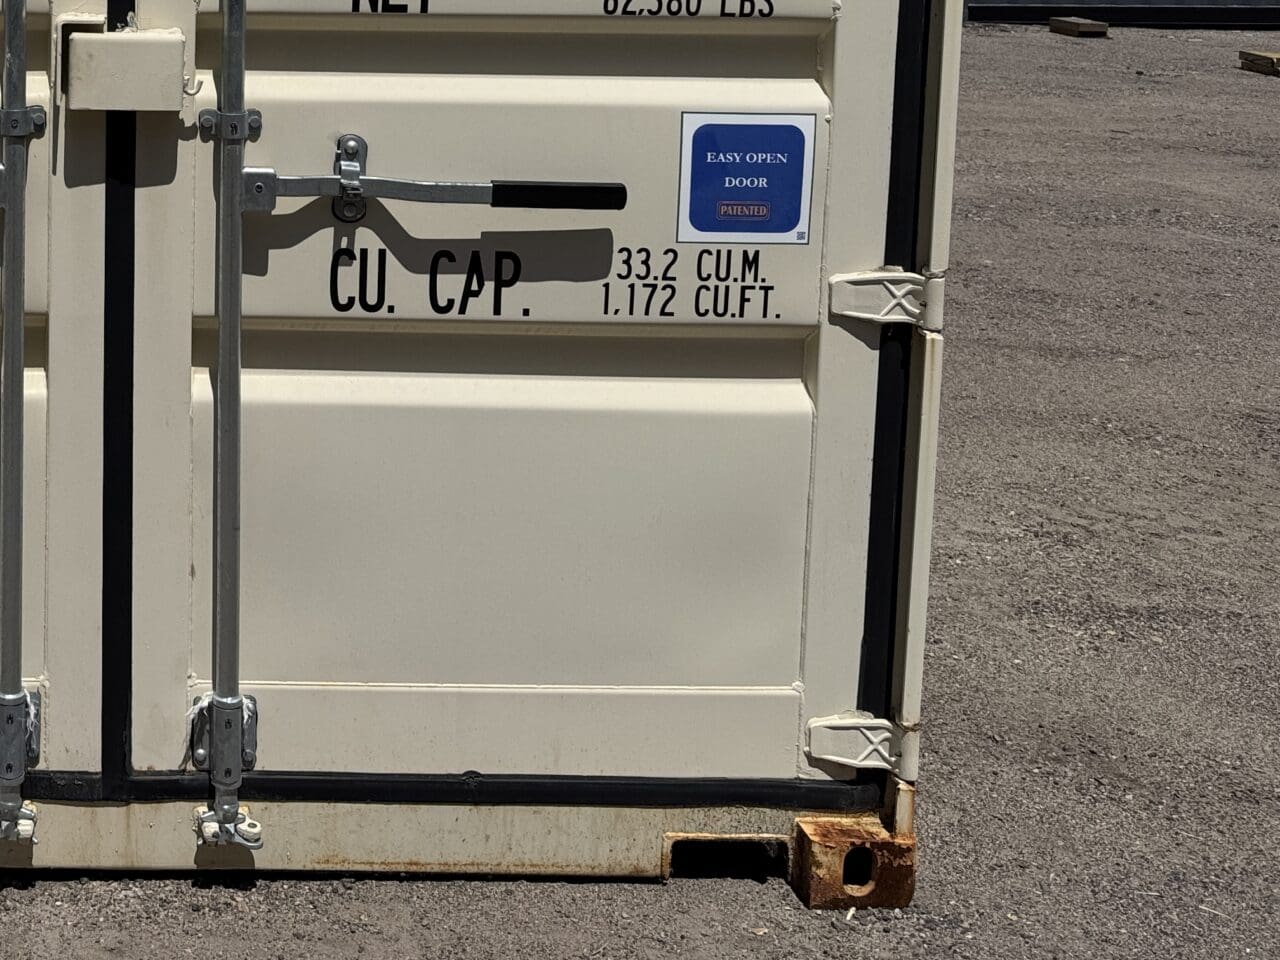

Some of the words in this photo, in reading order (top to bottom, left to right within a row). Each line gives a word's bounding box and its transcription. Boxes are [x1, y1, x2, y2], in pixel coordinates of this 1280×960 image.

[706, 152, 743, 163] EASY
[746, 152, 789, 164] OPEN
[724, 176, 768, 188] DOOR
[720, 205, 768, 216] PATENTED
[329, 247, 395, 314] CU.
[428, 249, 531, 317] CAP.
[616, 246, 679, 282] 33.2
[696, 248, 767, 284] CU.M.
[602, 282, 675, 317] 1,172
[694, 284, 781, 319] CU.FT.
